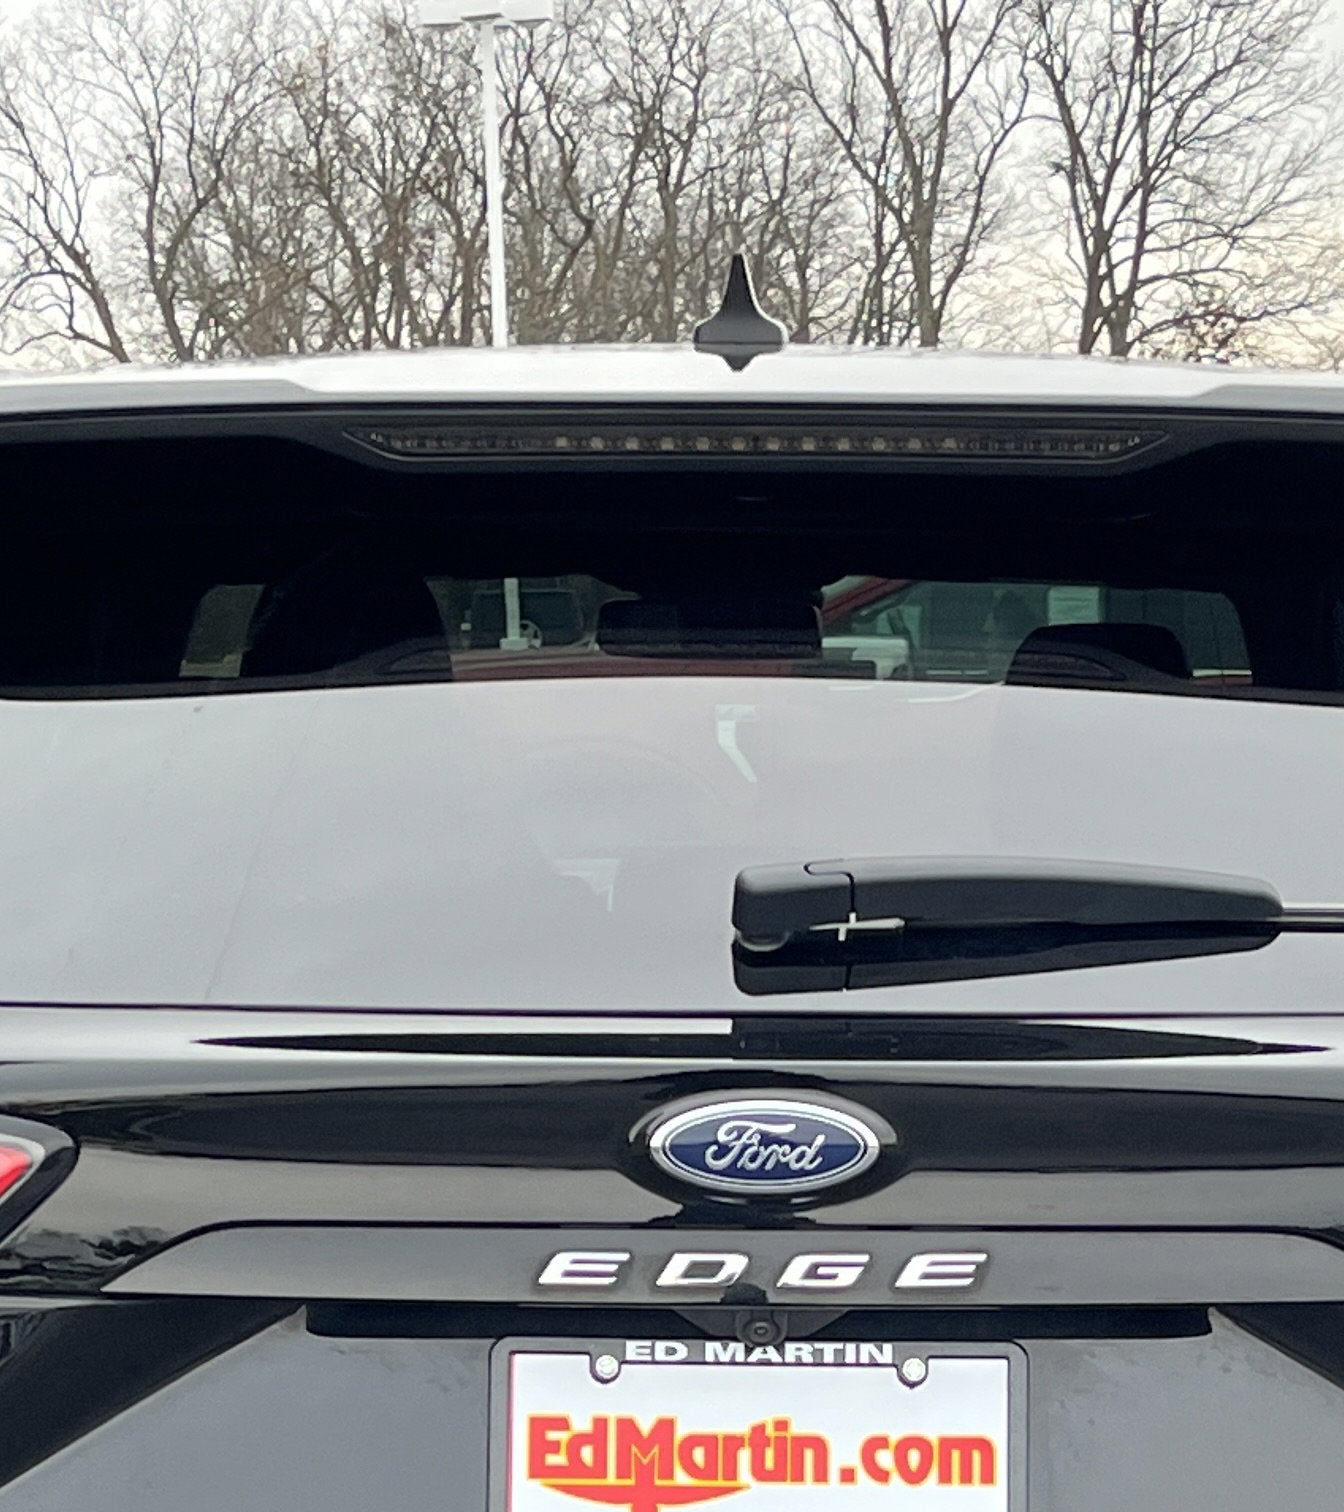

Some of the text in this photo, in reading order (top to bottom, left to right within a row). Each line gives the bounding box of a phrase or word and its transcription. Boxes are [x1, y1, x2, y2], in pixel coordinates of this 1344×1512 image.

[704, 1119, 826, 1173] Ford
[537, 1251, 989, 1288] EDGE
[625, 1340, 894, 1364] ED MARTIN
[527, 1414, 997, 1487] EdMartin.com
